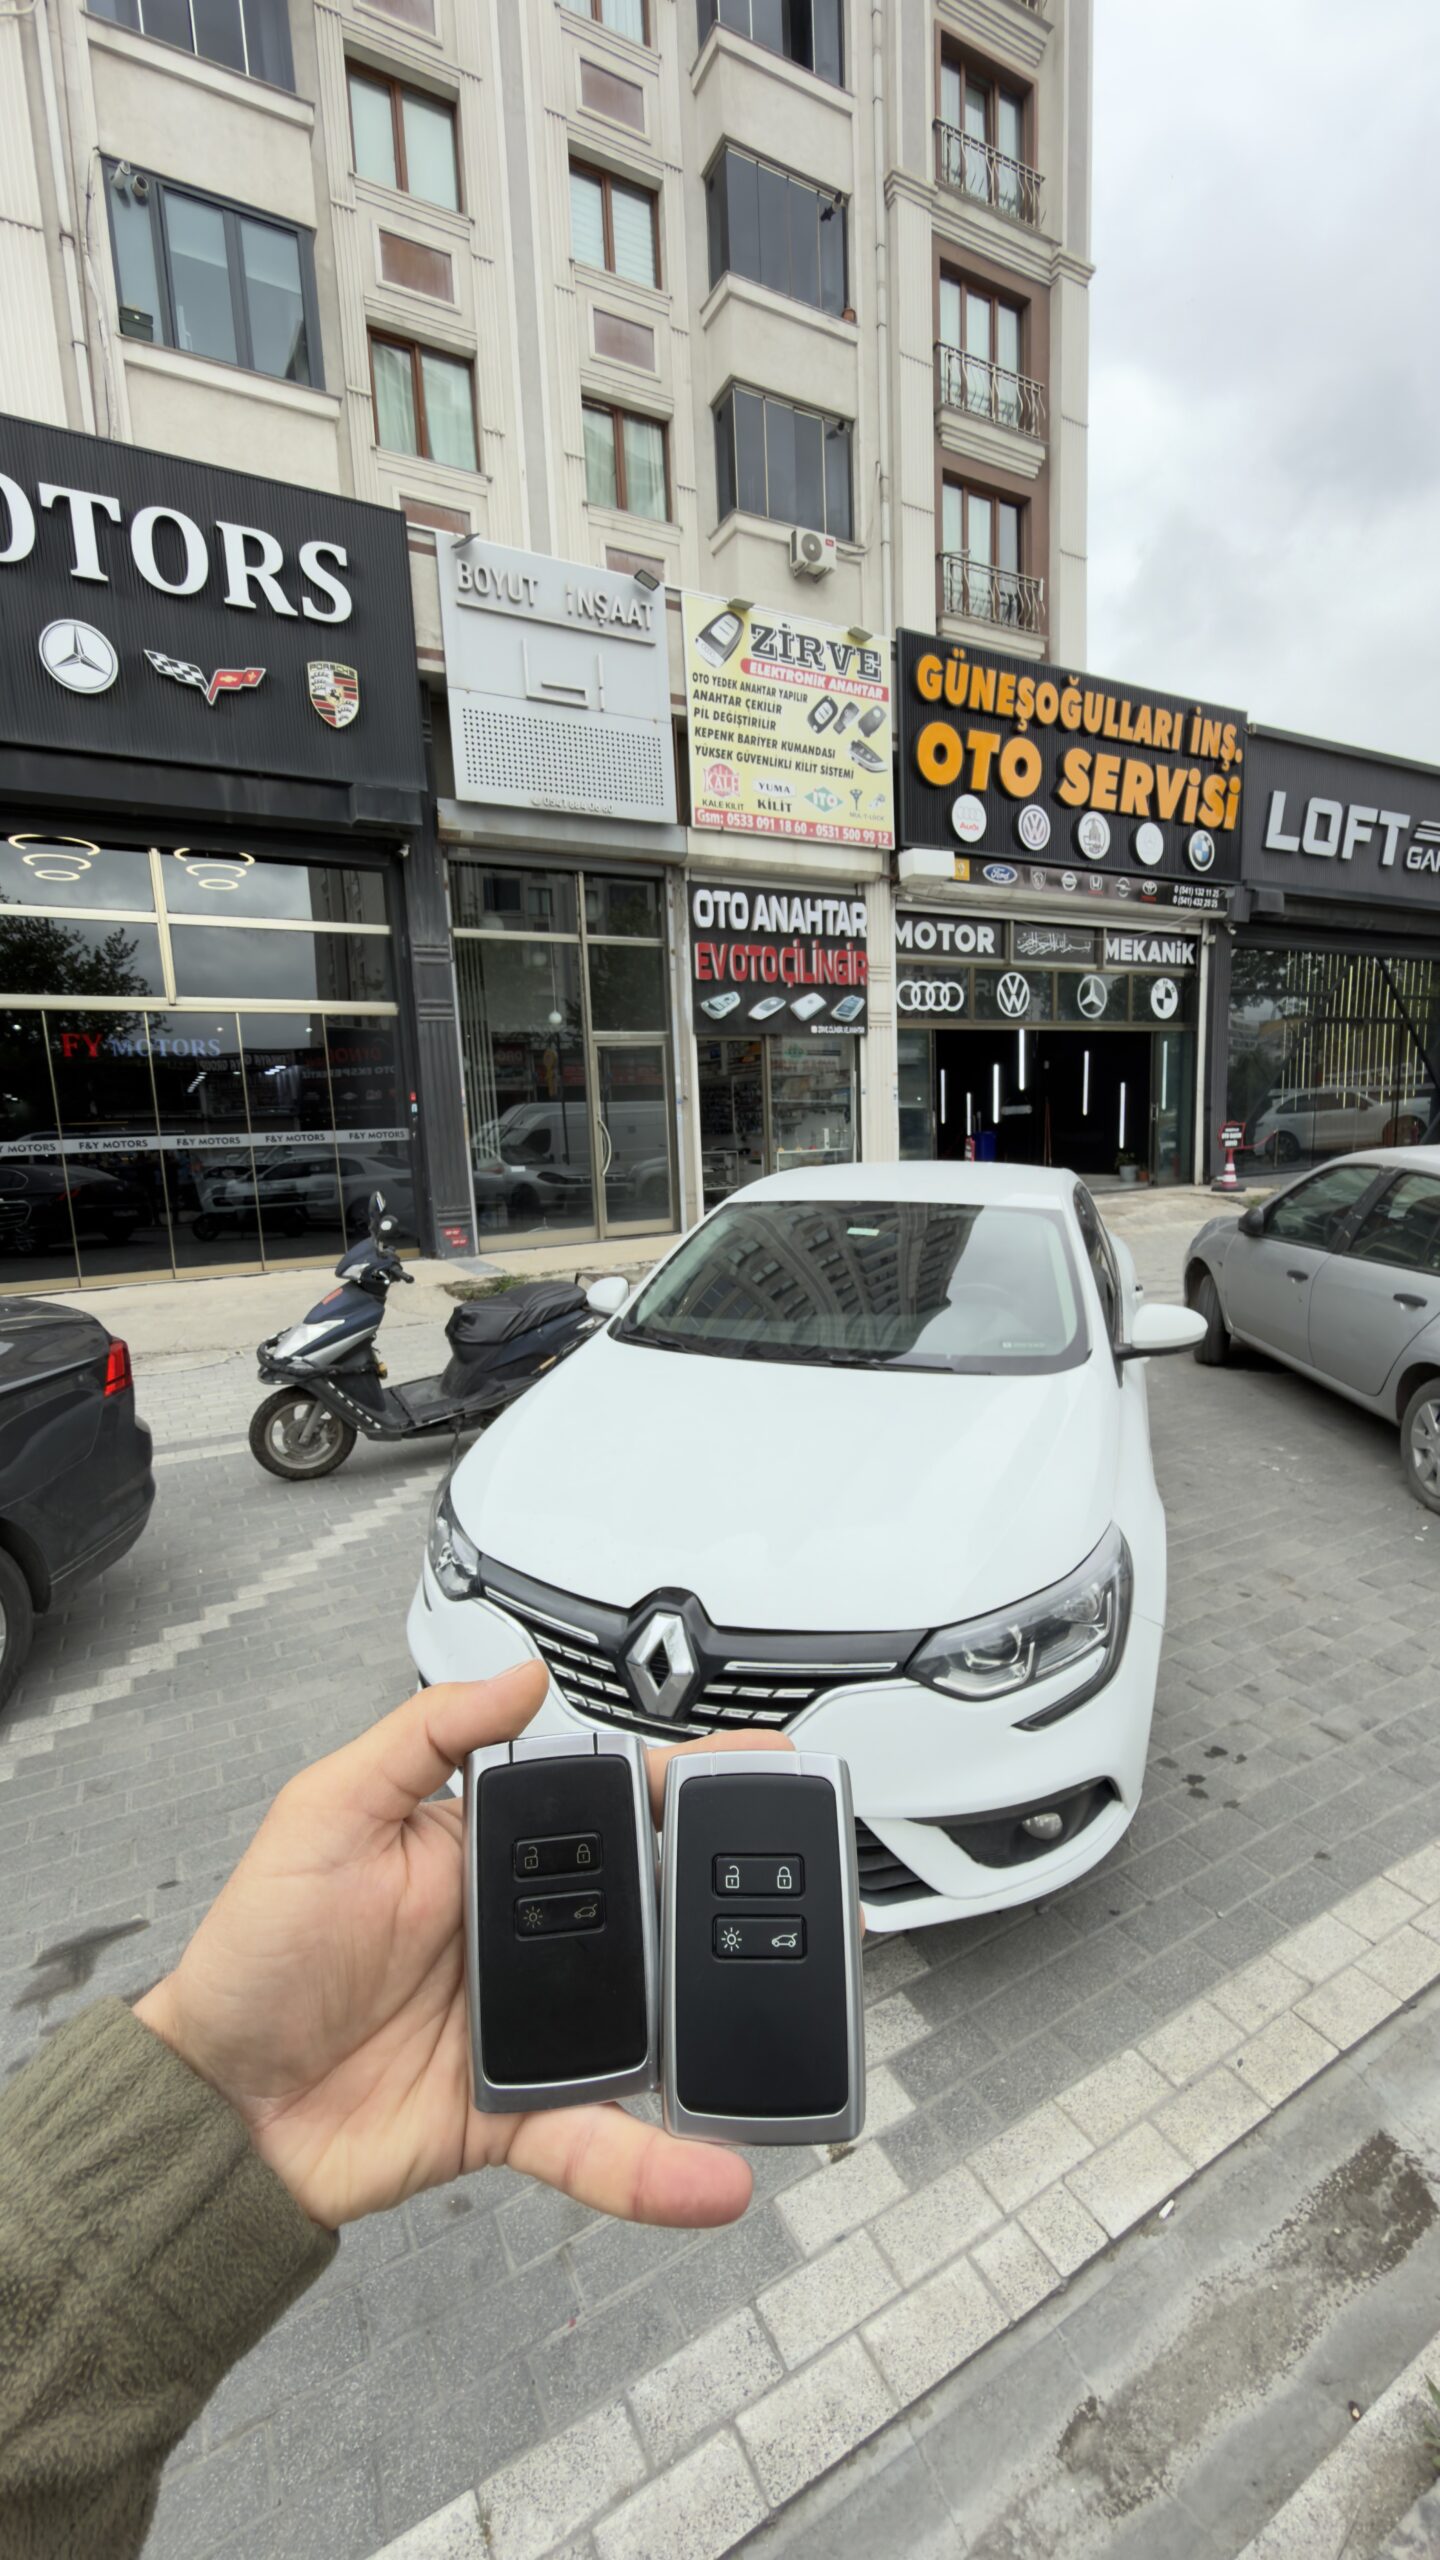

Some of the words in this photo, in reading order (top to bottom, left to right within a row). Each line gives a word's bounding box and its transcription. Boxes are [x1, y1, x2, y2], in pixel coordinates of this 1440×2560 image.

[455, 558, 540, 608] BOYUT
[566, 583, 654, 631] İNŞAAT
[750, 623, 882, 683] ZİRVE
[309, 662, 356, 677] PORSCHE
[749, 661, 826, 688] ELEKTRONİK
[828, 679, 884, 699] ANAHTAR
[692, 672, 710, 684] OTO
[711, 675, 738, 690] YEDEK
[739, 681, 776, 697] ANAHTAR
[778, 688, 808, 703] YAPILIR
[692, 689, 742, 707] ANAHTAR
[745, 698, 782, 714] ÇEKİLİR
[915, 647, 1183, 752] GÜNEŞOĞULLARI
[1191, 706, 1244, 771] İNŞ.
[693, 705, 709, 719] PİL
[713, 709, 777, 731] DEĞİŞTİRİLİR
[694, 726, 734, 742] KEPENK
[737, 732, 778, 749] BARİYER
[781, 741, 836, 759] KUMANDASI
[694, 742, 733, 761] YÜKSEK
[736, 749, 792, 770] GÜVENLİKLİ
[794, 760, 818, 775] KİLİT
[820, 763, 854, 779] SİSTEMİ
[704, 770, 740, 793] KALE
[758, 782, 791, 794] YUMA
[915, 721, 1043, 800] OTO
[1058, 746, 1242, 832] SERVİSİ
[702, 798, 724, 809] KALE
[757, 798, 793, 813] KİLİT
[812, 787, 839, 807] İTO
[697, 809, 724, 825] Gsm:
[727, 814, 753, 827] 0533
[756, 818, 775, 831] 091
[779, 821, 791, 832] 18
[794, 823, 807, 835] 60
[816, 825, 839, 839] 0531
[842, 828, 861, 841] 500
[862, 830, 875, 843] 99
[877, 833, 889, 845] 12
[1265, 790, 1412, 867] LOFT
[693, 888, 749, 931] OTO
[752, 894, 869, 938] ANAHTAR
[895, 920, 995, 955] MOTOR
[1105, 937, 1196, 965] MEKANİK
[694, 942, 728, 981] EV
[729, 944, 778, 984] OTO
[779, 938, 869, 988] ÇİLİNGİR
[60, 1032, 103, 1058] FY
[111, 1038, 222, 1058] MOTORS
[8, 1143, 56, 1153] MOTORS
[78, 1140, 101, 1151] F&Y
[102, 1139, 149, 1150] MOTORS
[176, 1137, 197, 1147] F&Y
[199, 1136, 241, 1146] MOTORS
[265, 1134, 283, 1144] F&Y
[285, 1133, 325, 1143] MOTORS
[348, 1131, 366, 1141] F&Y
[367, 1130, 405, 1140] MOTORS
